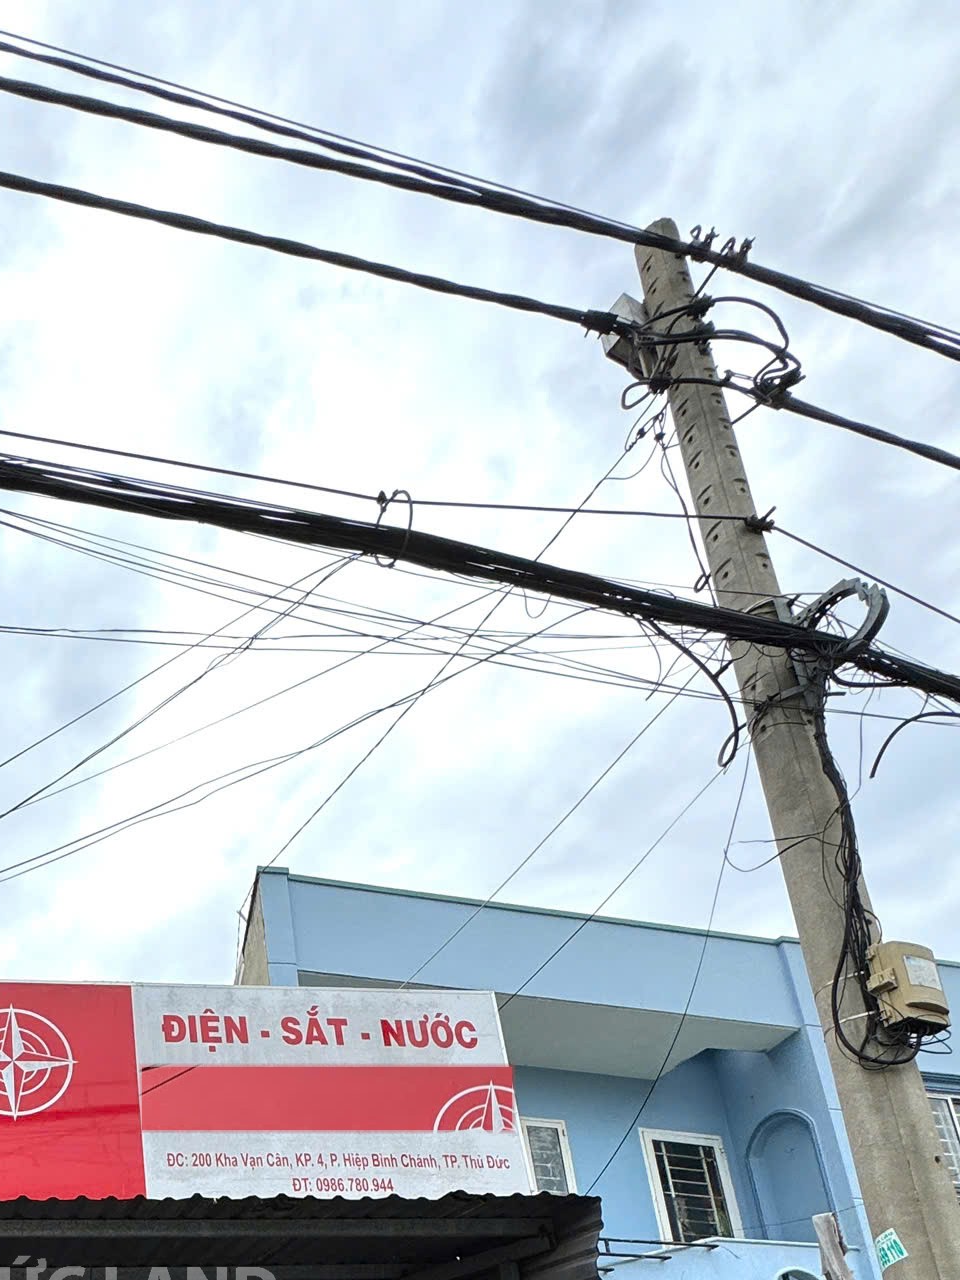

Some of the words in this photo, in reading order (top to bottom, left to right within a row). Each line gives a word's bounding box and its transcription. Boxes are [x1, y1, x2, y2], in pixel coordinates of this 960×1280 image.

[162, 1009, 249, 1052] ĐIỆN
[281, 1005, 348, 1045] SẮT
[382, 1012, 478, 1049] NƯỚC
[167, 1153, 189, 1167] ĐC:
[192, 1153, 212, 1167] 200
[215, 1153, 238, 1167] Kha
[240, 1153, 263, 1170] Vạn
[266, 1153, 293, 1169] Cân,
[295, 1153, 315, 1167] KP.
[317, 1153, 328, 1169] 4,
[330, 1154, 341, 1168] P.
[343, 1154, 369, 1171] Hiệp
[372, 1153, 398, 1168] Bình
[401, 1154, 441, 1170] Chánh,
[442, 1155, 461, 1169] TP.
[462, 1154, 484, 1169] Thủ
[487, 1155, 510, 1169] Đức
[292, 1178, 312, 1192] ĐT:
[316, 1178, 394, 1192] 0986.780.944
